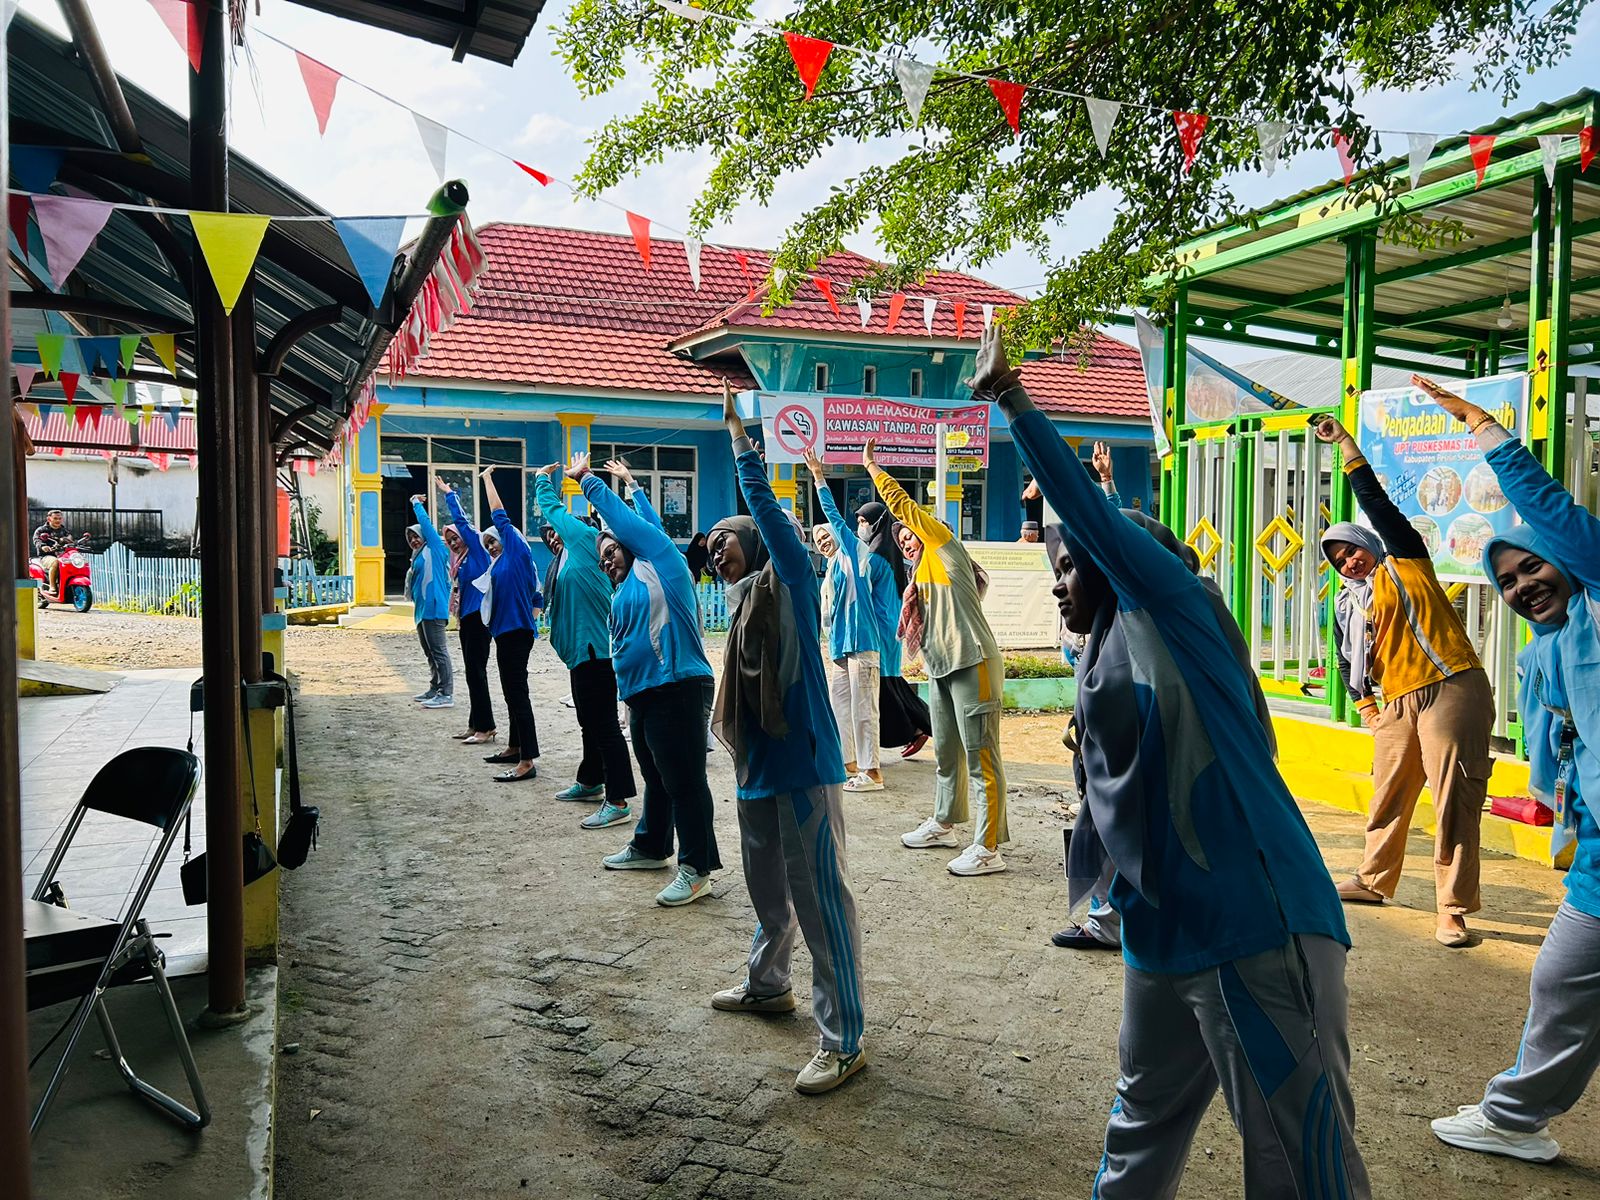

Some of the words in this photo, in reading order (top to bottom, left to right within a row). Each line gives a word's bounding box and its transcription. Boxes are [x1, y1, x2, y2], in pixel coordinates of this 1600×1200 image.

[827, 403, 863, 415] ANDA
[866, 404, 931, 419] MEMASUKI
[826, 419, 880, 432] KAWASAN
[883, 421, 917, 433] TANPA
[1381, 410, 1447, 442] Pengadaan
[1394, 441, 1410, 455] UPT
[1411, 439, 1461, 454] PUSKESMAS
[876, 455, 891, 463] UPT
[892, 456, 932, 464] PUSKESMAS
[1404, 454, 1435, 464] Kabupaten
